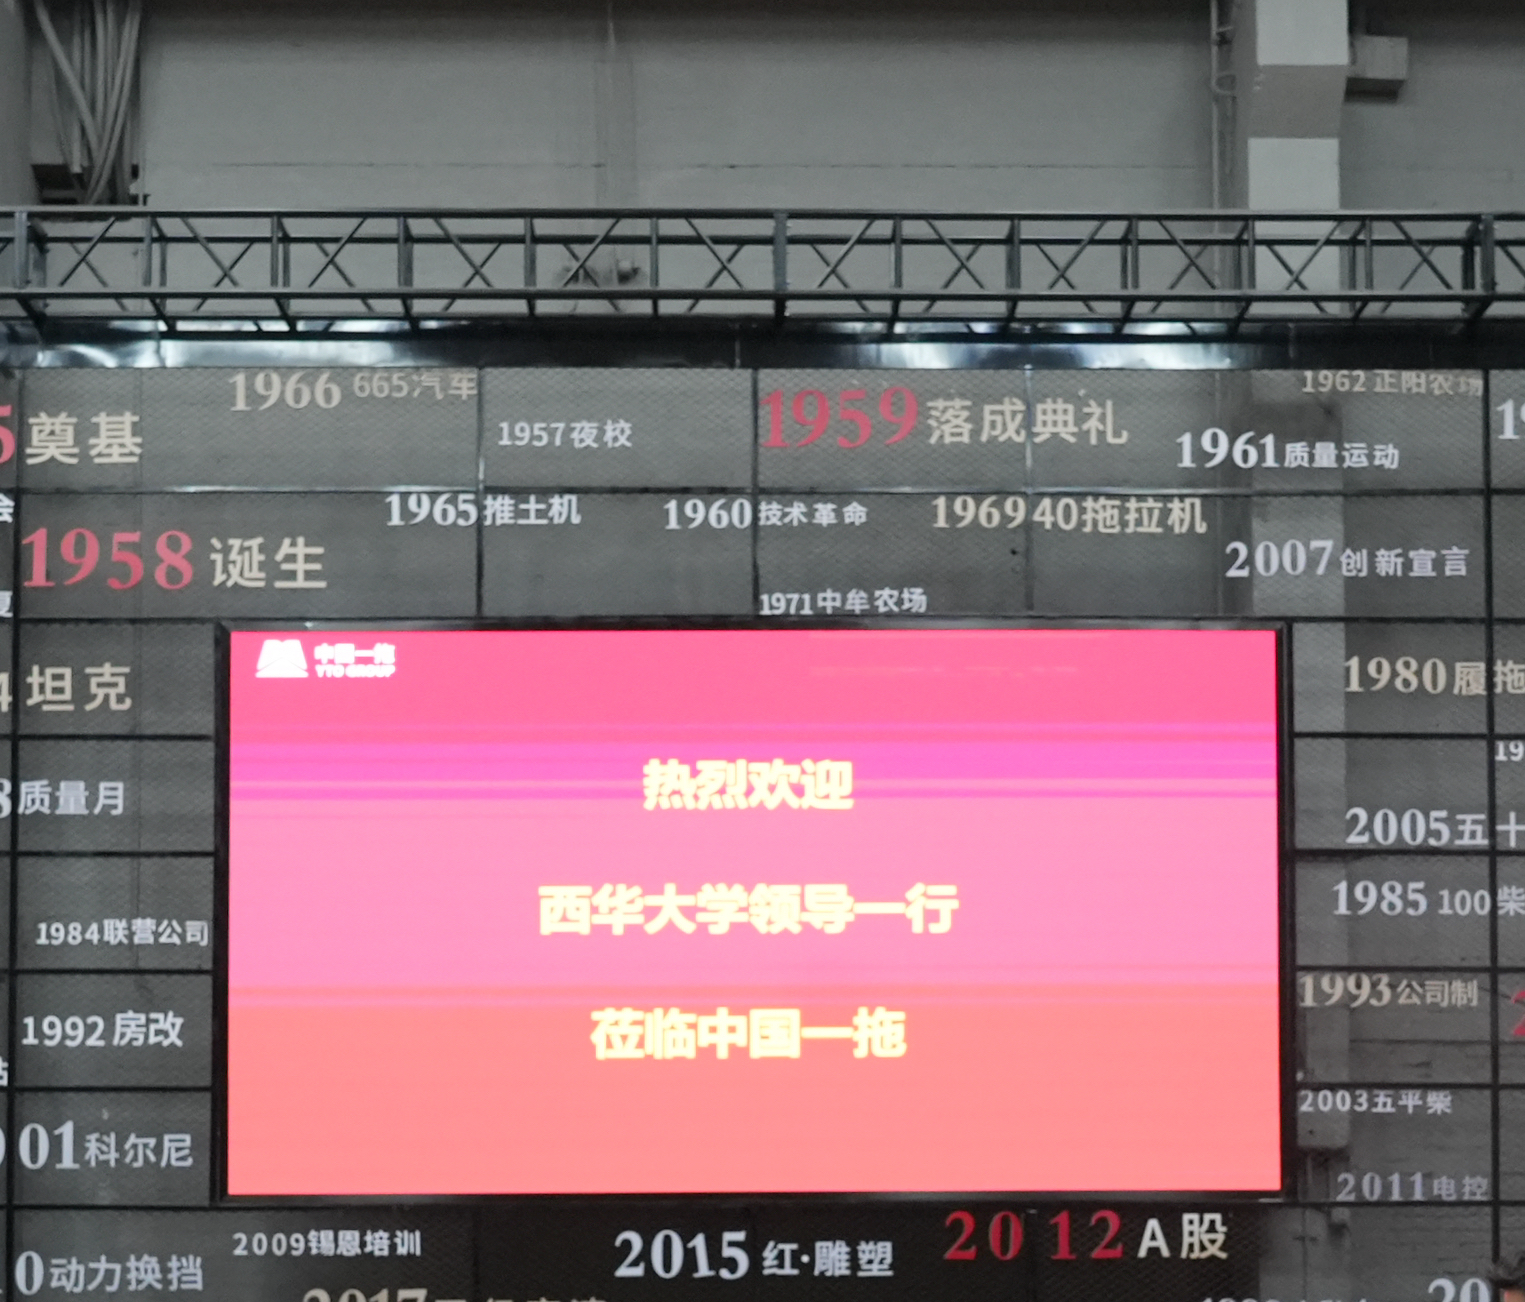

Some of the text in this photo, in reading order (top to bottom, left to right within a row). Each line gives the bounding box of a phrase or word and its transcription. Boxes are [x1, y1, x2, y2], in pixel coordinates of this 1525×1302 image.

[228, 371, 479, 411] 1966 665汽车
[1302, 369, 1366, 394] 1962
[759, 386, 1129, 448] 1959 落成典礼
[25, 411, 143, 465] 奠基
[663, 498, 868, 529] 1960 技术革命
[22, 527, 328, 589] 1958 诞生
[1225, 539, 1469, 579] 2007 创新宣言
[1344, 655, 1448, 696] 1980
[18, 780, 125, 816] 质量月
[642, 758, 855, 811] 热烈欢迎
[1344, 806, 1452, 848] 2005
[538, 881, 960, 936] 西华大学领导一行
[1332, 880, 1429, 917] 1985
[1298, 973, 1479, 1010] 1993 公司制
[590, 1006, 908, 1061] 莅临中国一拖
[84, 1130, 195, 1169] 科尔尼
[1336, 1170, 1489, 1202] 2011 电控
[612, 1228, 751, 1281] 2015
[942, 1208, 1229, 1262] 2012 A股
[49, 1253, 205, 1295] 动力换挡
